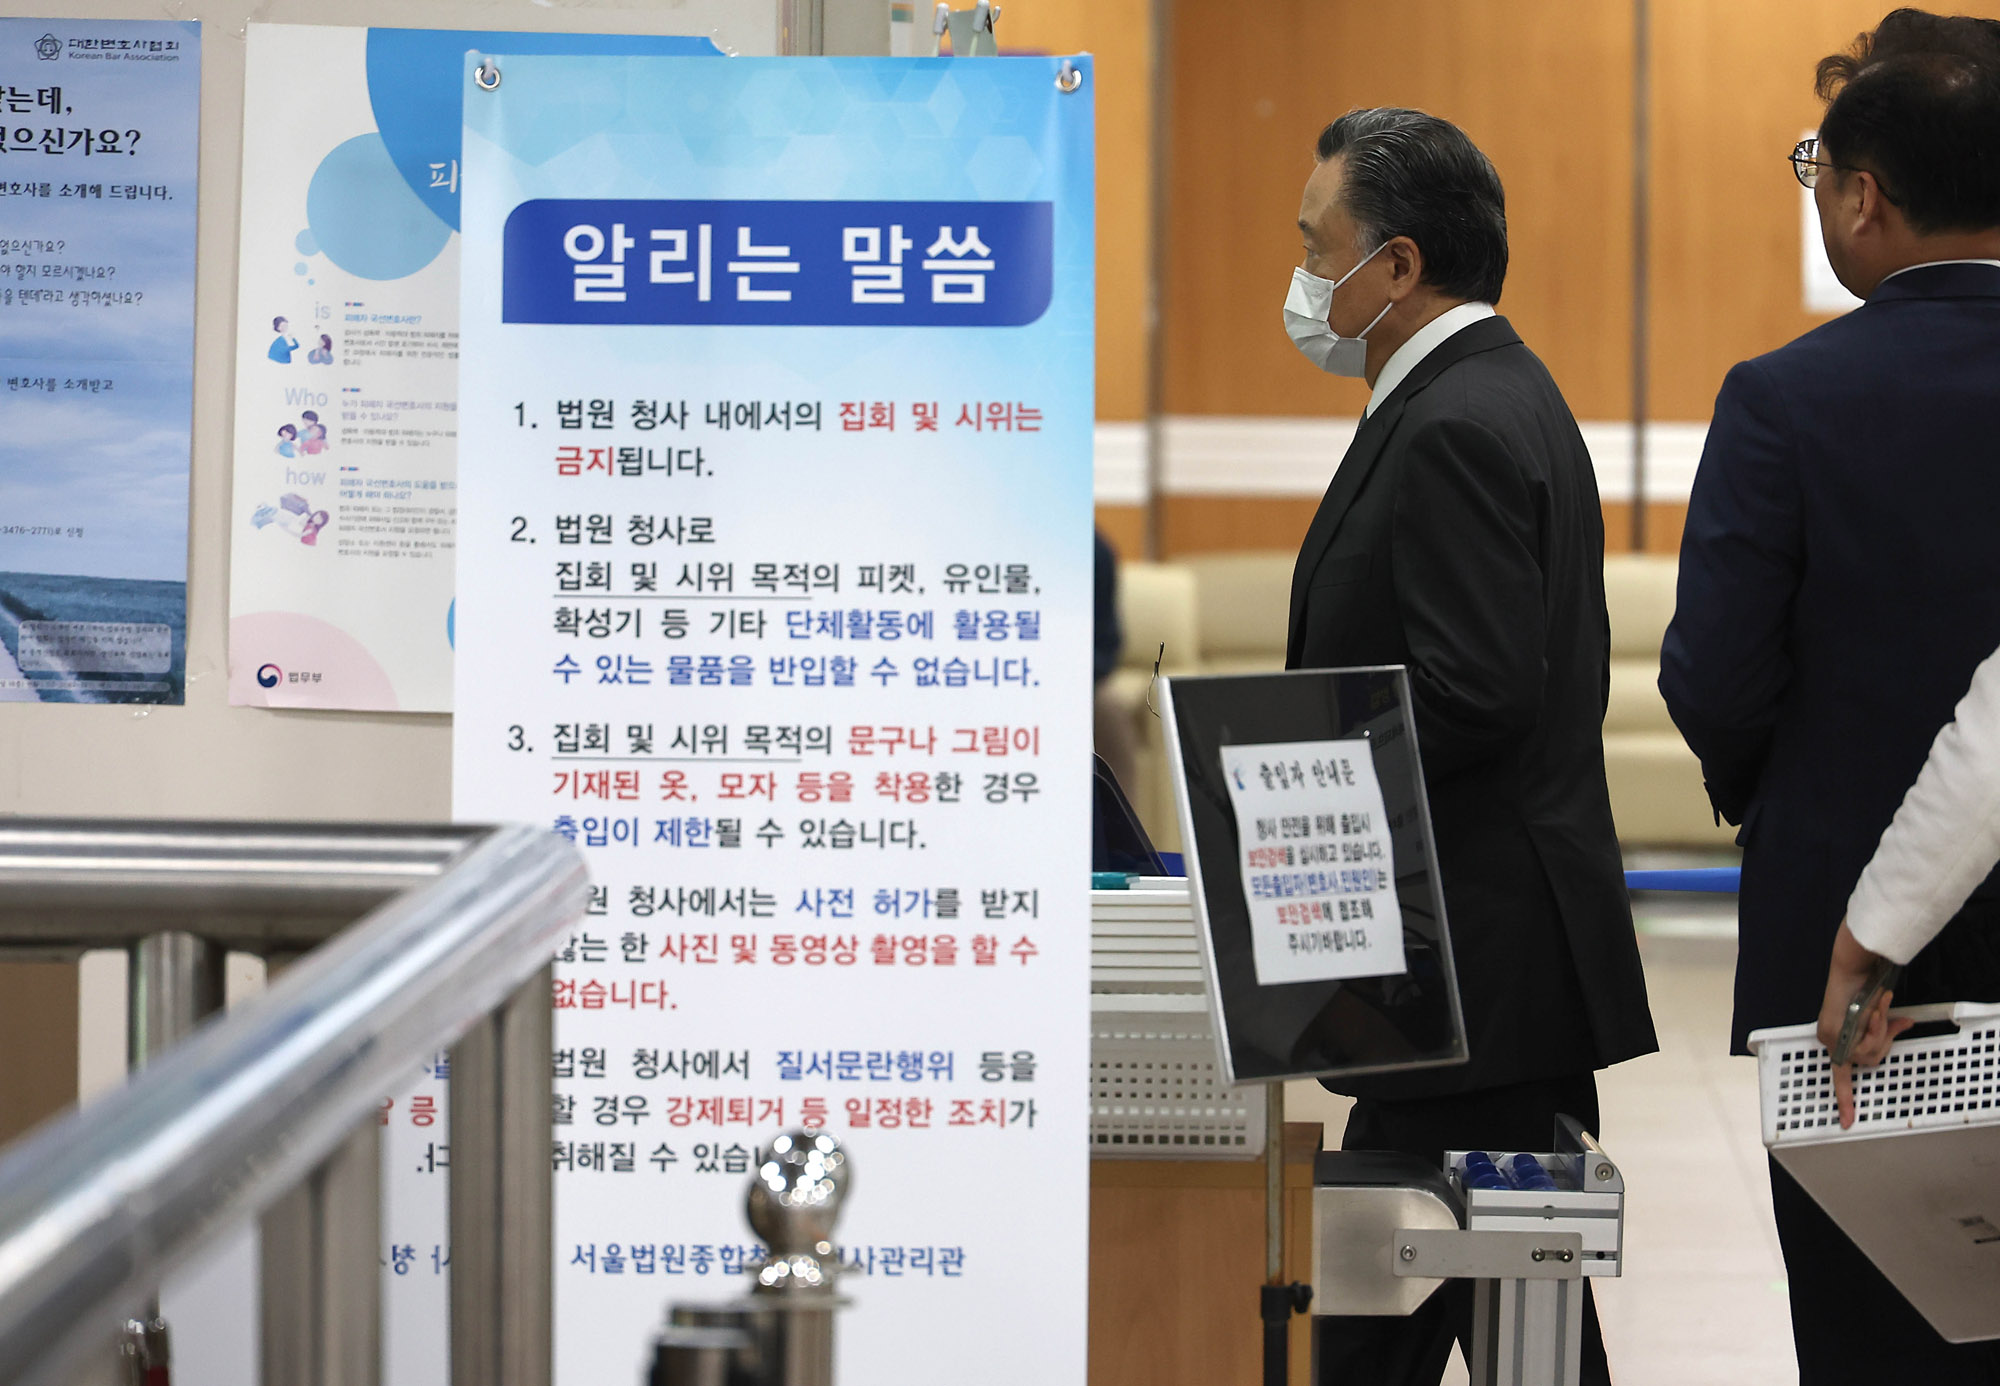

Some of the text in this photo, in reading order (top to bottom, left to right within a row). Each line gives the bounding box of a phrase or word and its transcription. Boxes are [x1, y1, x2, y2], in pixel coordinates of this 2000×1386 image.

[69, 39, 179, 51] 대한변호사협회
[124, 53, 179, 61] Association
[109, 185, 172, 200] 드립니다.
[564, 224, 995, 303] 알리는 말씀
[315, 301, 331, 320] is
[285, 388, 328, 407] Who
[515, 400, 1042, 431] 1. 법원 청사 내에서의 집회 및 시위는
[286, 467, 326, 487] how
[556, 447, 712, 476] 금지됩니다.
[511, 514, 715, 545] 2. 법원 청사로
[556, 561, 1040, 594] 집회 및 시위 목적의 피켓, 유인물,
[554, 607, 1039, 641] 확성기 등 기타 단체활동에 활용될
[288, 672, 321, 683] 법무부
[553, 654, 1039, 687] 수 있는 물품을 반입할 수 없습니다.
[508, 724, 1039, 756] 3. 집회 및 시위 목적의 문구나 그림이
[554, 770, 1039, 803] 기재된 옷, 모자 등을 착용한 경우
[1260, 759, 1355, 790] 출입자 안내문
[654, 817, 741, 848] 제한될
[756, 818, 784, 848] 수
[800, 819, 925, 849] 있습니다.
[629, 886, 776, 917] 청사에서는
[796, 888, 853, 917] 사전
[874, 888, 961, 919] 허가를
[981, 889, 1038, 919] 받지
[621, 933, 648, 962] 한
[660, 934, 717, 963] 사진
[731, 935, 756, 964] 및
[770, 935, 858, 965] 동영상
[871, 934, 958, 966] 촬영을
[972, 935, 998, 965] 할
[1010, 936, 1038, 965] 수
[552, 976, 676, 1013] 없습니다.
[552, 1046, 1037, 1082] 법원 청사에서 질서문란행위 등을
[594, 1096, 649, 1126] 경우
[667, 1096, 783, 1127] 강제퇴거
[800, 1097, 828, 1129] 등
[845, 1097, 933, 1128] 일정한
[949, 1099, 1037, 1128] 조치가
[650, 1143, 677, 1172] 수
